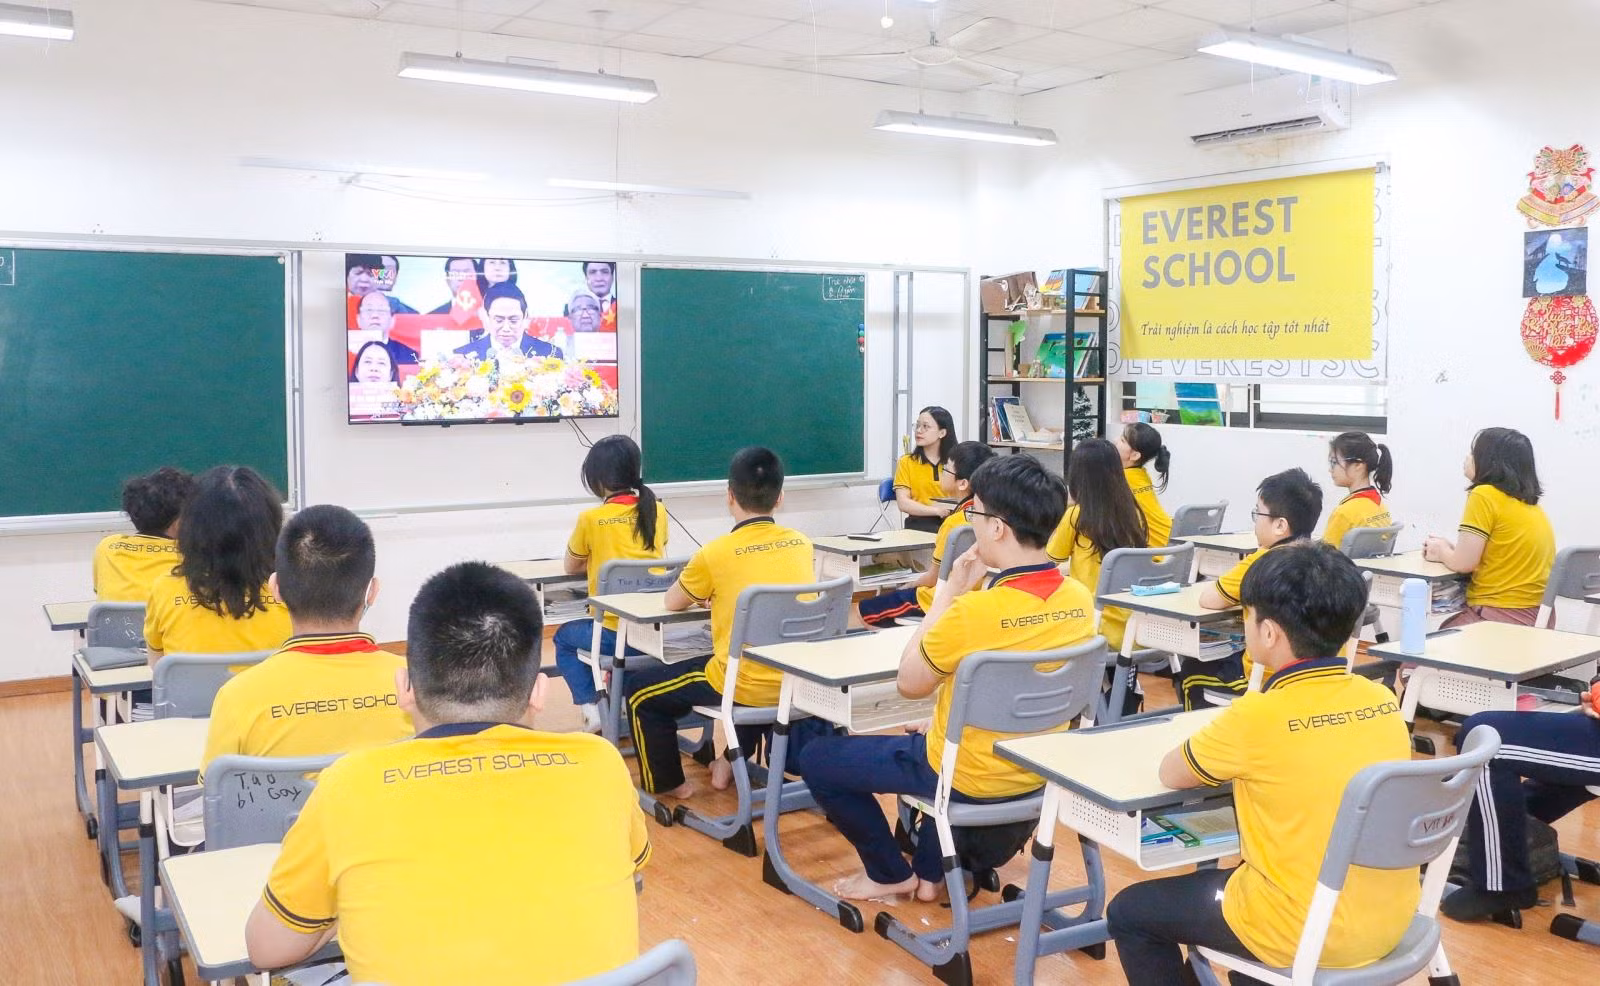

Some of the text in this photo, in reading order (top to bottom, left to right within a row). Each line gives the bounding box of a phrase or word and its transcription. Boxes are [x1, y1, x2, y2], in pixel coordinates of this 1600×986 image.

[1142, 196, 1298, 245] EVEREST
[1142, 246, 1296, 289] SCHOOL
[1165, 320, 1200, 341] nghiệm
[1203, 320, 1213, 335] là
[1216, 319, 1238, 334] cách
[1242, 320, 1258, 337] học
[1262, 320, 1281, 340] tập
[1284, 319, 1300, 334] tốt
[1303, 317, 1330, 334] nhất
[146, 544, 179, 553] SCHOO
[735, 543, 774, 556] EVEREST
[1001, 608, 1086, 629] EVEREST SCHOOL
[271, 693, 398, 719] EVEREST SCHO
[1288, 711, 1353, 732] EVEREST
[383, 752, 579, 784] EVEREST SCHOOL
